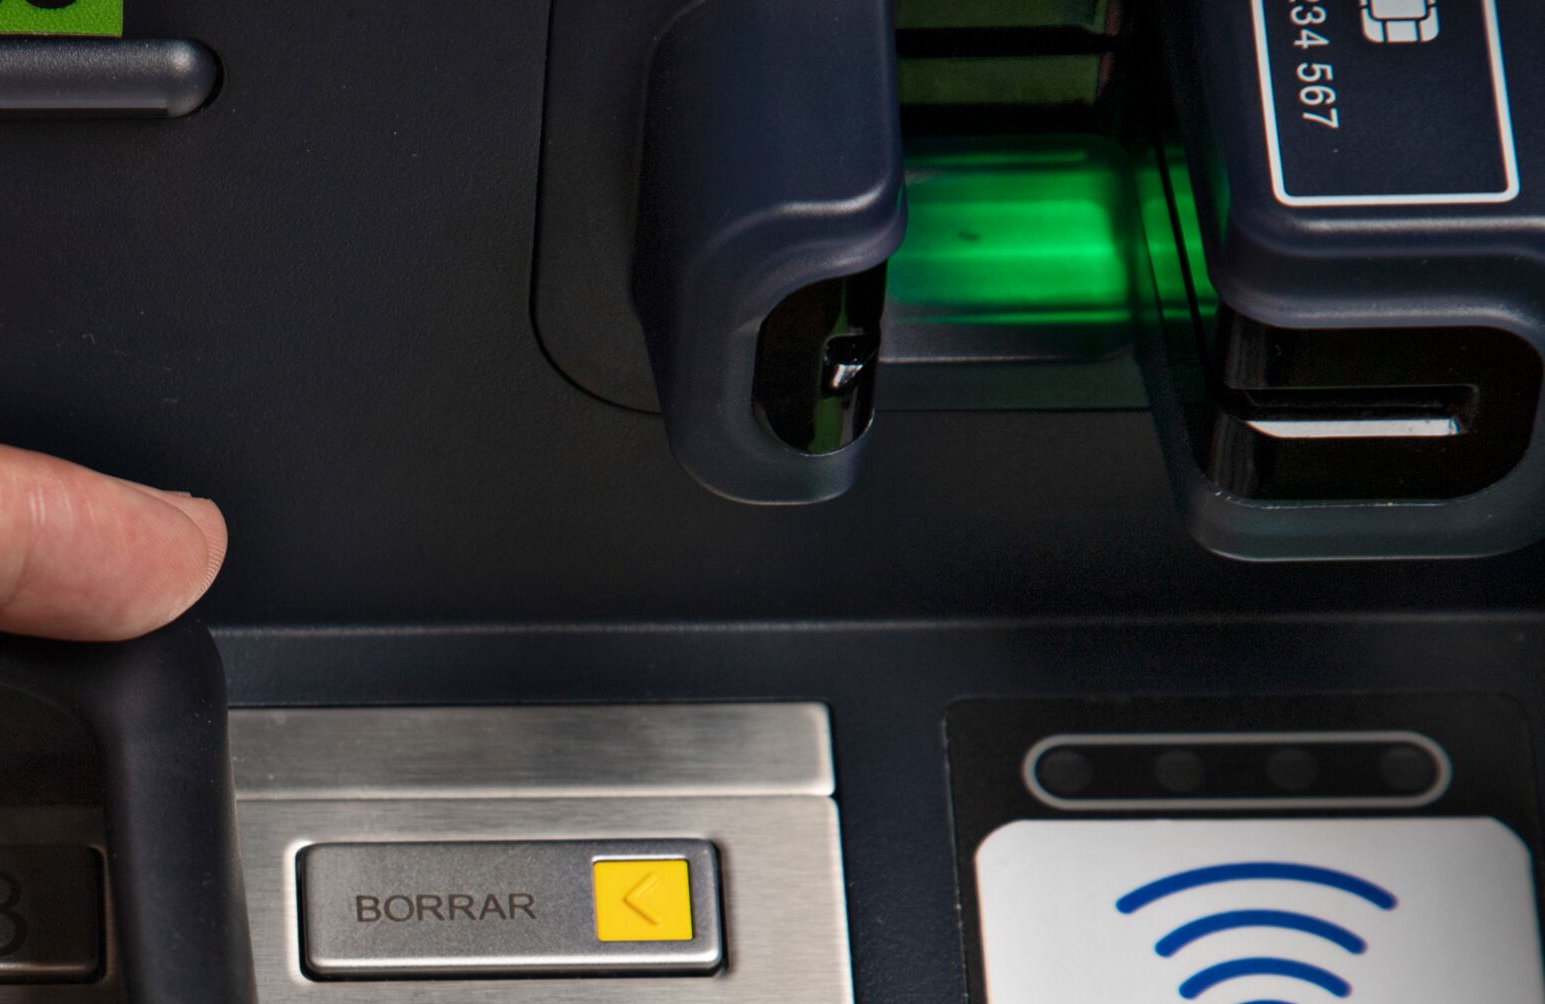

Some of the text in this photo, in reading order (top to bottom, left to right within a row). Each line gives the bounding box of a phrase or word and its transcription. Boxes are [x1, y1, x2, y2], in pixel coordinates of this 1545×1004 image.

[1289, 0, 1339, 129] 34 567
[355, 893, 537, 923] BORRAR
